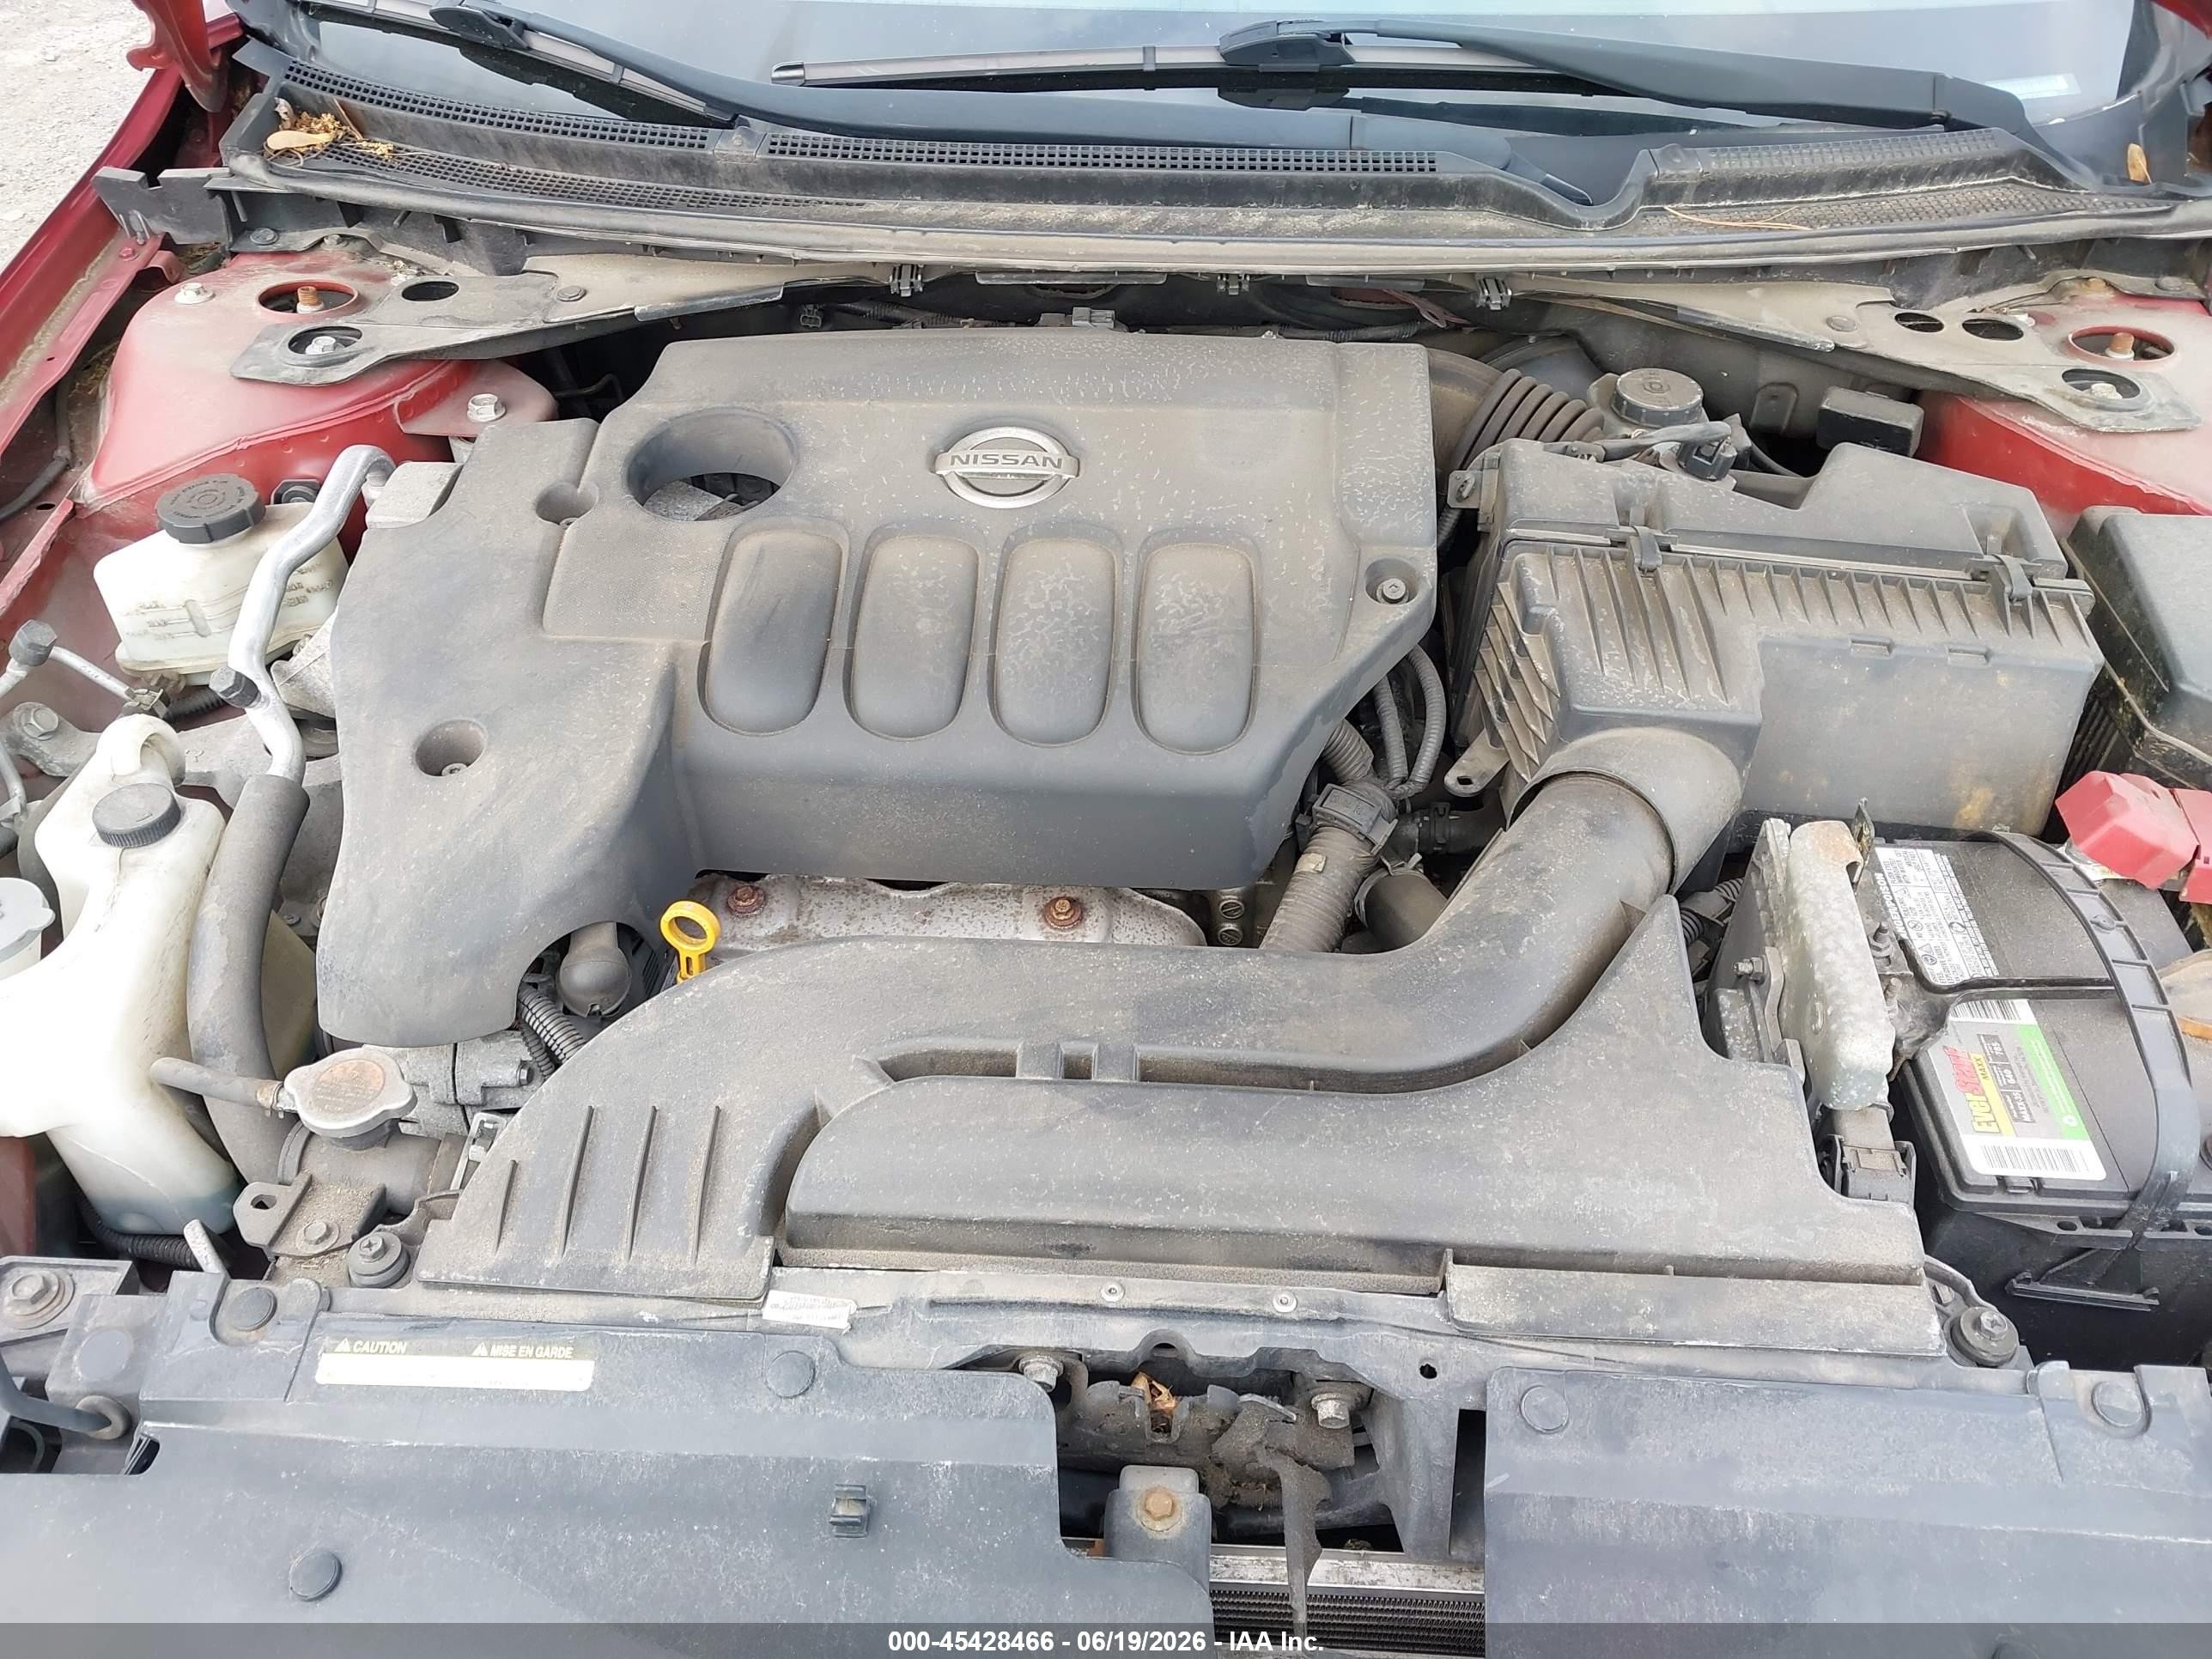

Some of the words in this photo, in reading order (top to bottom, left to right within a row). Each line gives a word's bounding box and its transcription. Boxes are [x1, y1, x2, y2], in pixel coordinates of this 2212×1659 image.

[950, 453, 1062, 470] NISSAN
[1974, 1057, 1990, 1080] MAXX
[1943, 1046, 2000, 1133] EverStart
[353, 1340, 407, 1354] CAUTION
[490, 1345, 515, 1357] MISE
[518, 1346, 534, 1358] EN
[535, 1346, 574, 1358] GARDE
